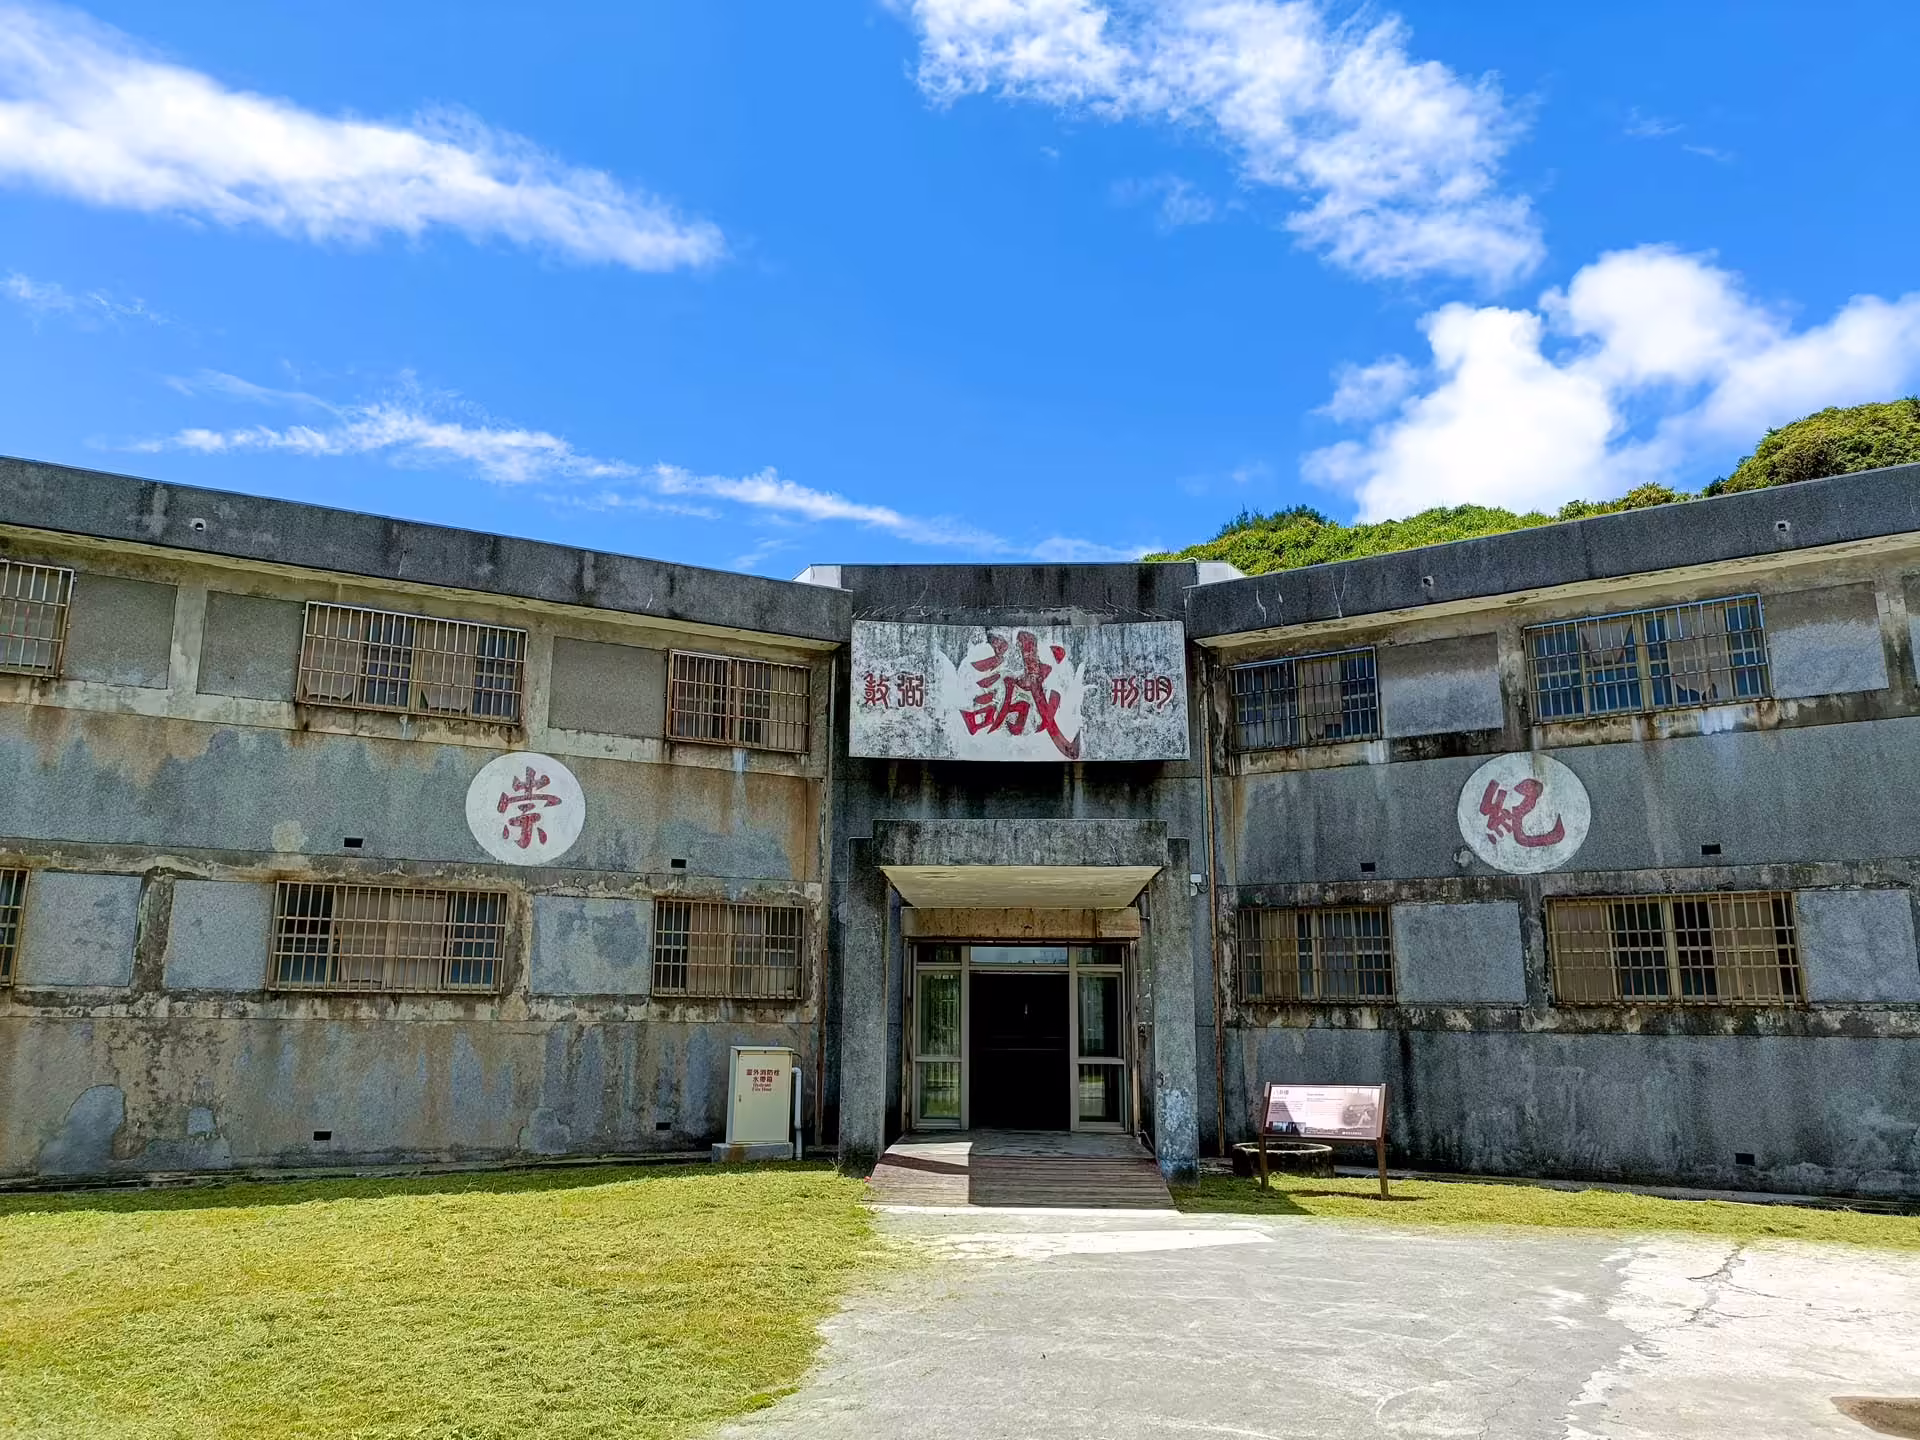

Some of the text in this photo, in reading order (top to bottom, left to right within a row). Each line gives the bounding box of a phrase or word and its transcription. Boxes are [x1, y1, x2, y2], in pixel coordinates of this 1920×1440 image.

[960, 631, 1081, 760] 誠
[497, 766, 562, 849] 崇
[1480, 778, 1565, 847] 紀
